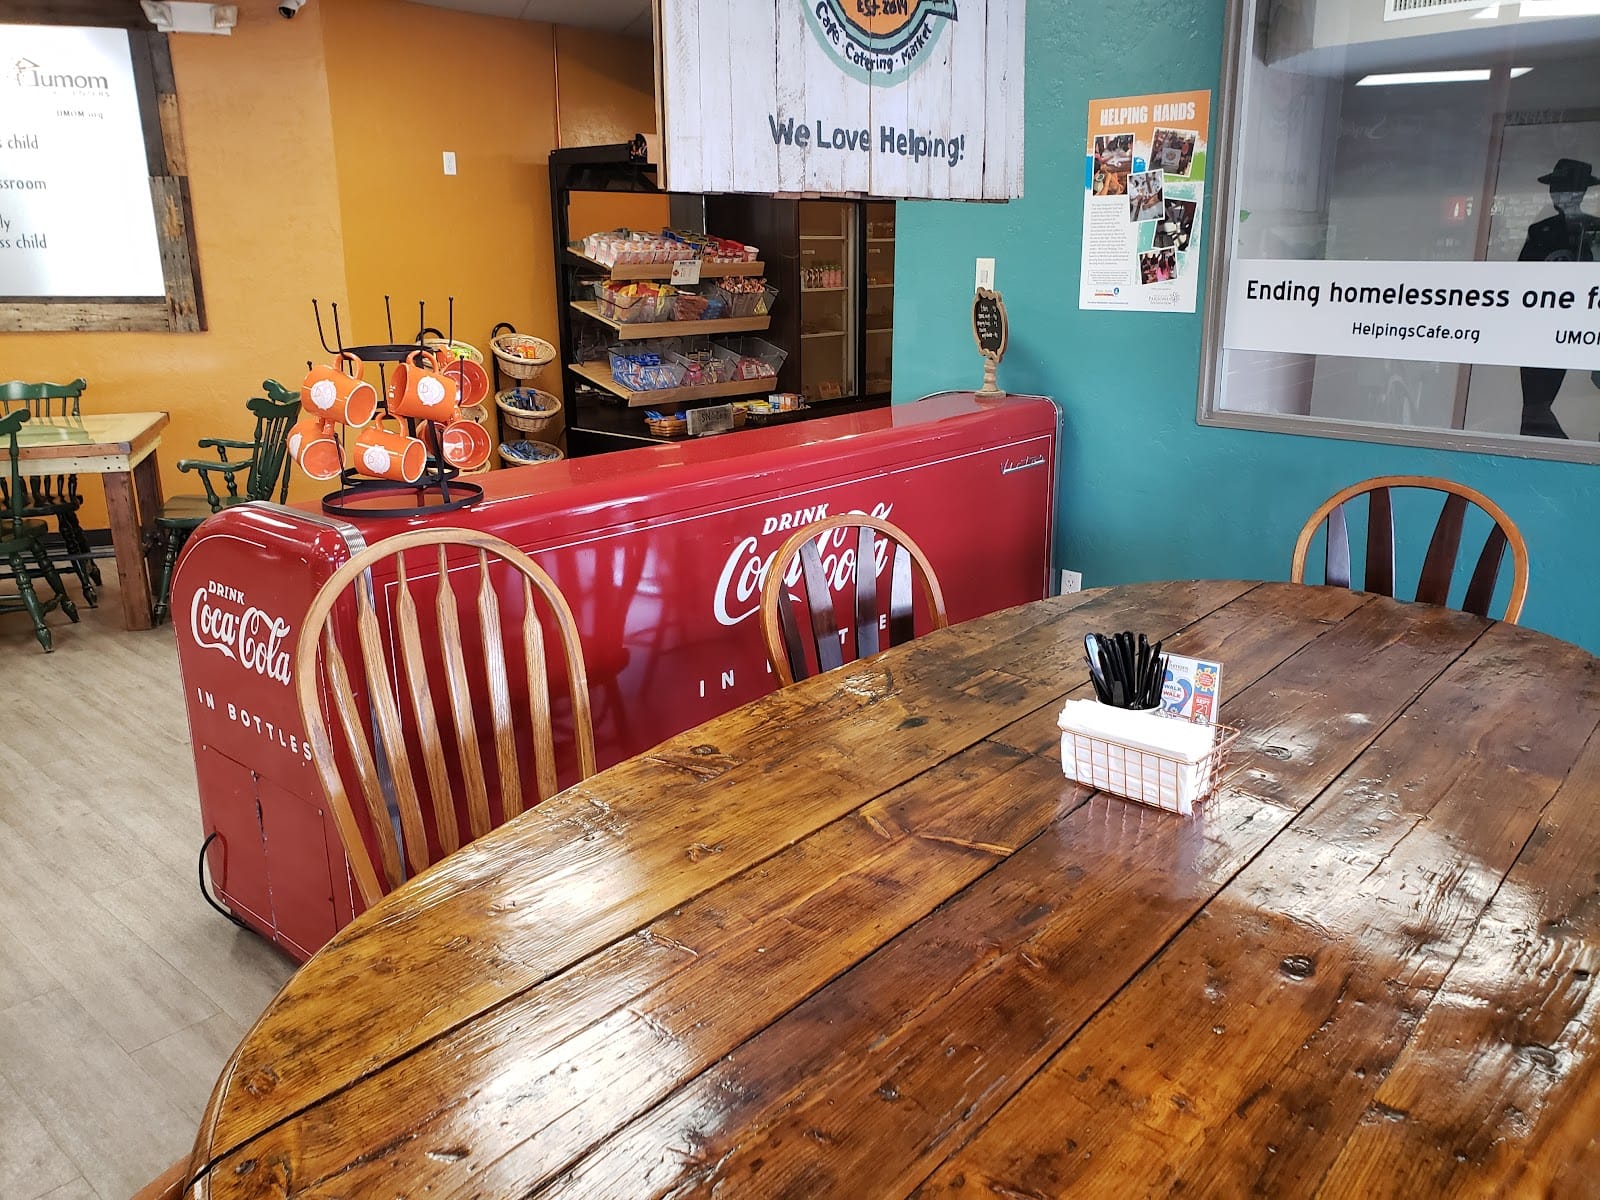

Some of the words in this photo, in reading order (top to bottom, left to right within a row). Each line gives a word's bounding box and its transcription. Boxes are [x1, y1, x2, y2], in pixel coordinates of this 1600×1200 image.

[845, 44, 893, 74] Catering
[901, 22, 932, 65] Market
[1100, 106, 1149, 127] HELPING
[1153, 101, 1197, 122] HANDS
[7, 133, 39, 150] child
[768, 115, 811, 147] We
[816, 120, 871, 152] Love
[880, 125, 965, 168] Helping!
[16, 233, 48, 249] child
[1246, 280, 1320, 307] Ending
[1329, 282, 1510, 308] homelessness
[1521, 289, 1575, 309] one
[1352, 322, 1480, 344] HelpingsCafe.org
[1554, 330, 1600, 346] UMO
[761, 503, 829, 536] DRINK
[208, 580, 245, 605] DRINK
[699, 669, 735, 698] IN
[197, 687, 215, 710] IN
[227, 703, 313, 761] BOTTLES
